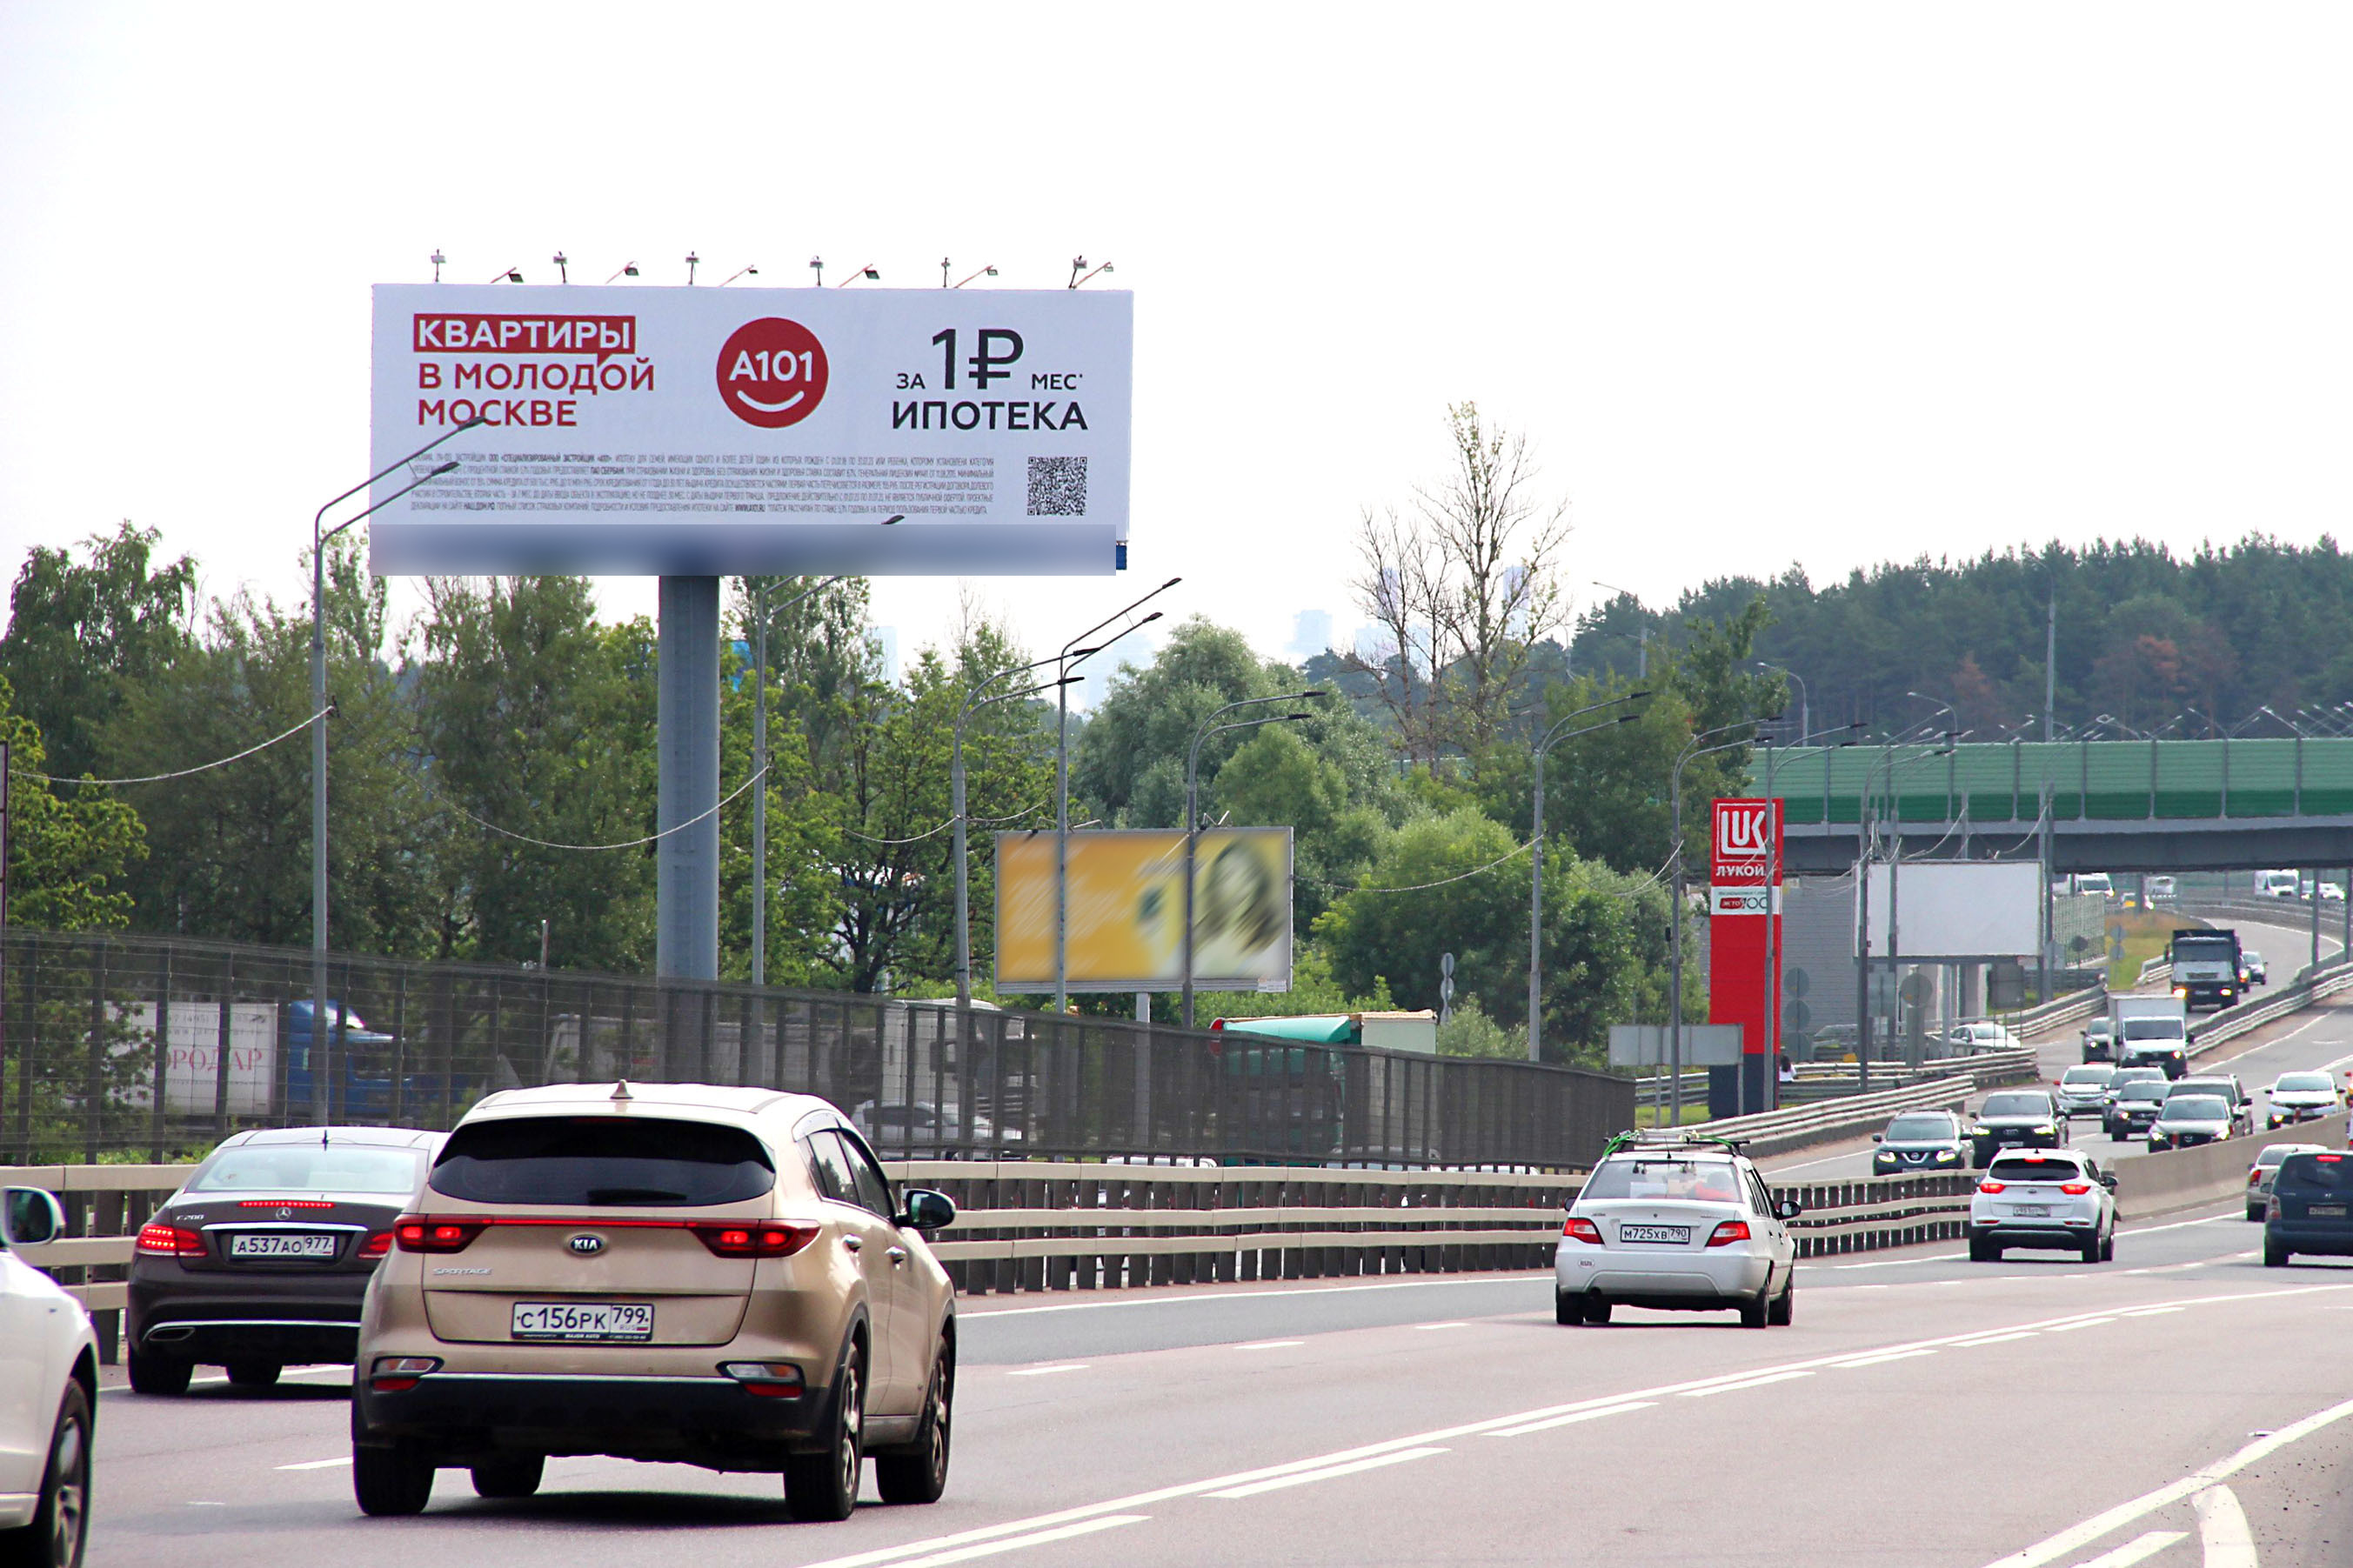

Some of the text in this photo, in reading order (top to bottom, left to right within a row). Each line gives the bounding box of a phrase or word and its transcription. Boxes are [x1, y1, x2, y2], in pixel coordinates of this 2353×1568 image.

[418, 319, 630, 349] КВАРТИРЫ
[419, 357, 654, 395] В МОЛОДОЙ
[729, 350, 812, 382] А101
[896, 373, 926, 390] ЗА
[418, 399, 577, 426] МОСКВЕ
[892, 402, 1088, 430] ИПОТЕКА
[1715, 863, 1774, 877] ЛУКОЙ
[237, 1237, 330, 1253] А537АО 977
[574, 1238, 598, 1249] KIA
[1623, 1228, 1687, 1240] М725ХВ 790
[520, 1306, 645, 1330] С156РК 799
